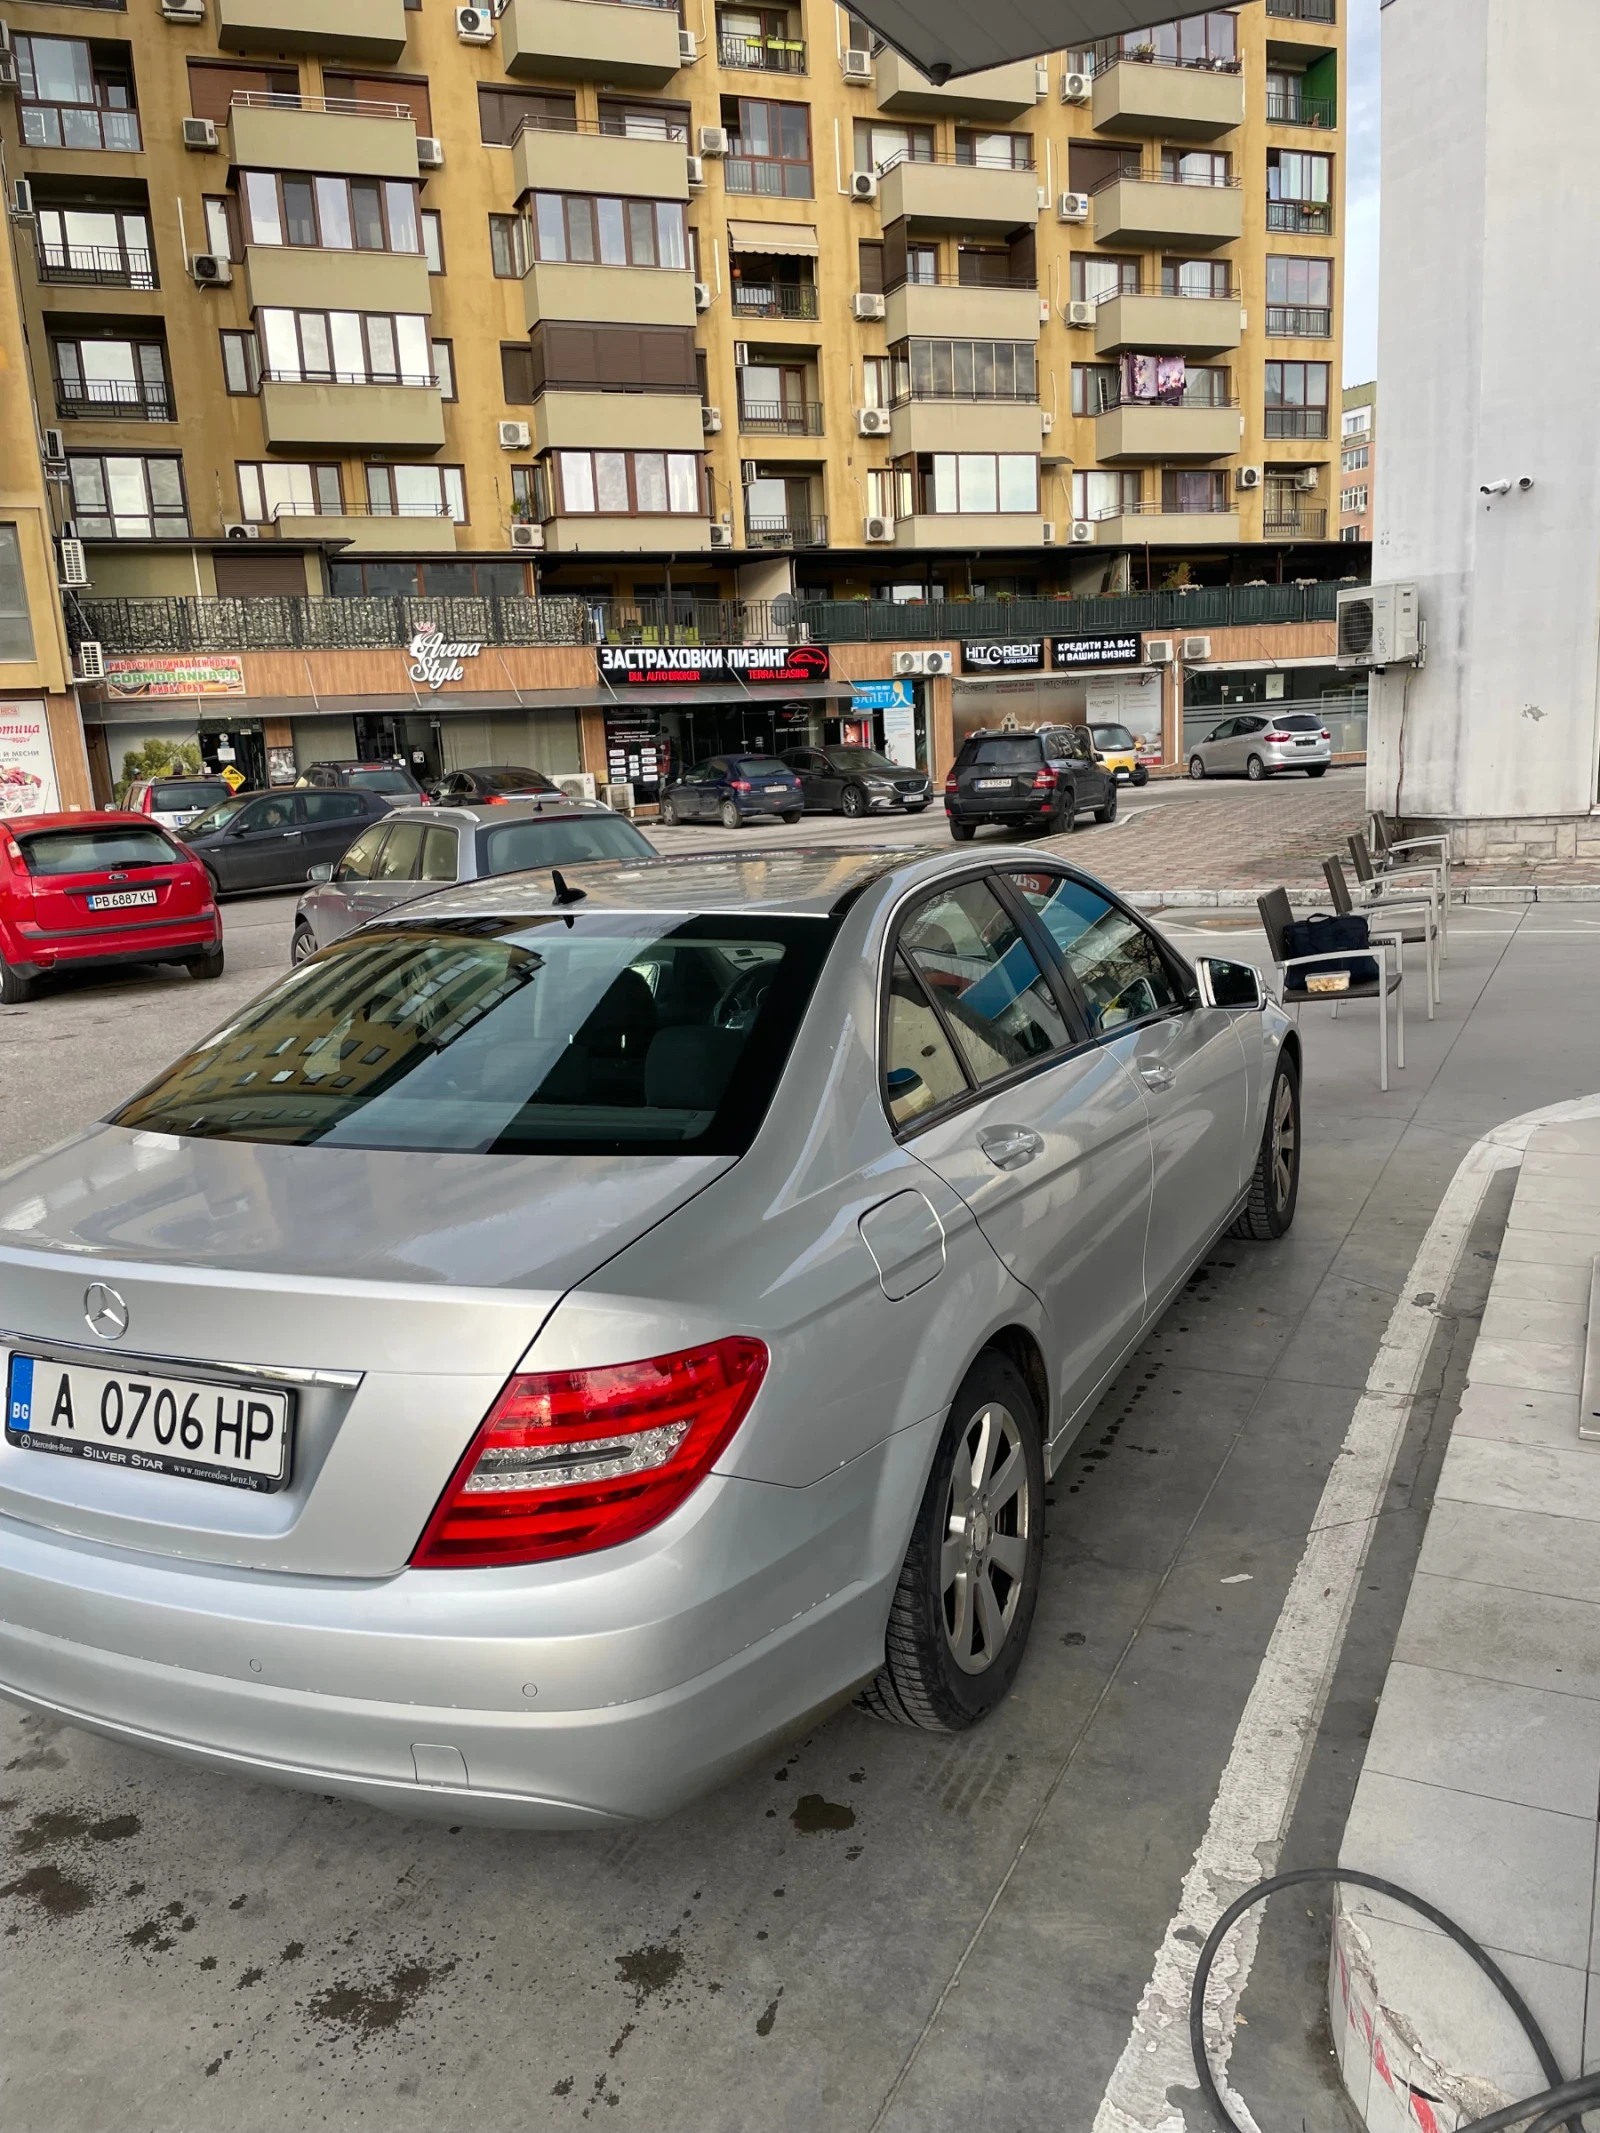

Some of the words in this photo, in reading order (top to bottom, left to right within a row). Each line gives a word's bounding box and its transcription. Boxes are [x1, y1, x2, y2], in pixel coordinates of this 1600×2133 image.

[422, 632, 481, 658] Arena
[1058, 642, 1100, 652] КРЕДИТИ
[1103, 640, 1117, 649] ЗА
[1118, 639, 1136, 648] ВАС
[601, 649, 723, 669] ЗАСТРАХОВКИ
[727, 649, 789, 668] ЛИЗИНГ
[1058, 652, 1065, 662] И
[1067, 651, 1100, 661] ВАШИЯ
[1101, 649, 1136, 660] БИЗНЕС
[110, 661, 156, 671] РИБАРСКИ
[156, 658, 237, 670] ПРИНАДЛЕЖНОСТИ
[410, 657, 464, 689] Style
[628, 671, 646, 682] BUL
[646, 671, 668, 681] AUTO
[668, 670, 700, 681] BROKER
[747, 669, 775, 680] TERRA
[775, 668, 808, 679] LEASING
[150, 684, 175, 694] ЖИВА
[175, 684, 205, 693] СТРЪВ
[94, 896, 110, 907] PB
[112, 893, 138, 906] 6887
[139, 891, 155, 903] KH
[12, 1402, 29, 1420] BG
[51, 1373, 74, 1429] A
[101, 1380, 203, 1450] 0706
[214, 1396, 274, 1460] HP
[32, 1439, 74, 1453] Mercedes-Benz
[82, 1445, 127, 1464] SILVER
[131, 1453, 164, 1471] STAR
[173, 1464, 258, 1488] www.mercedes-benz.bg
